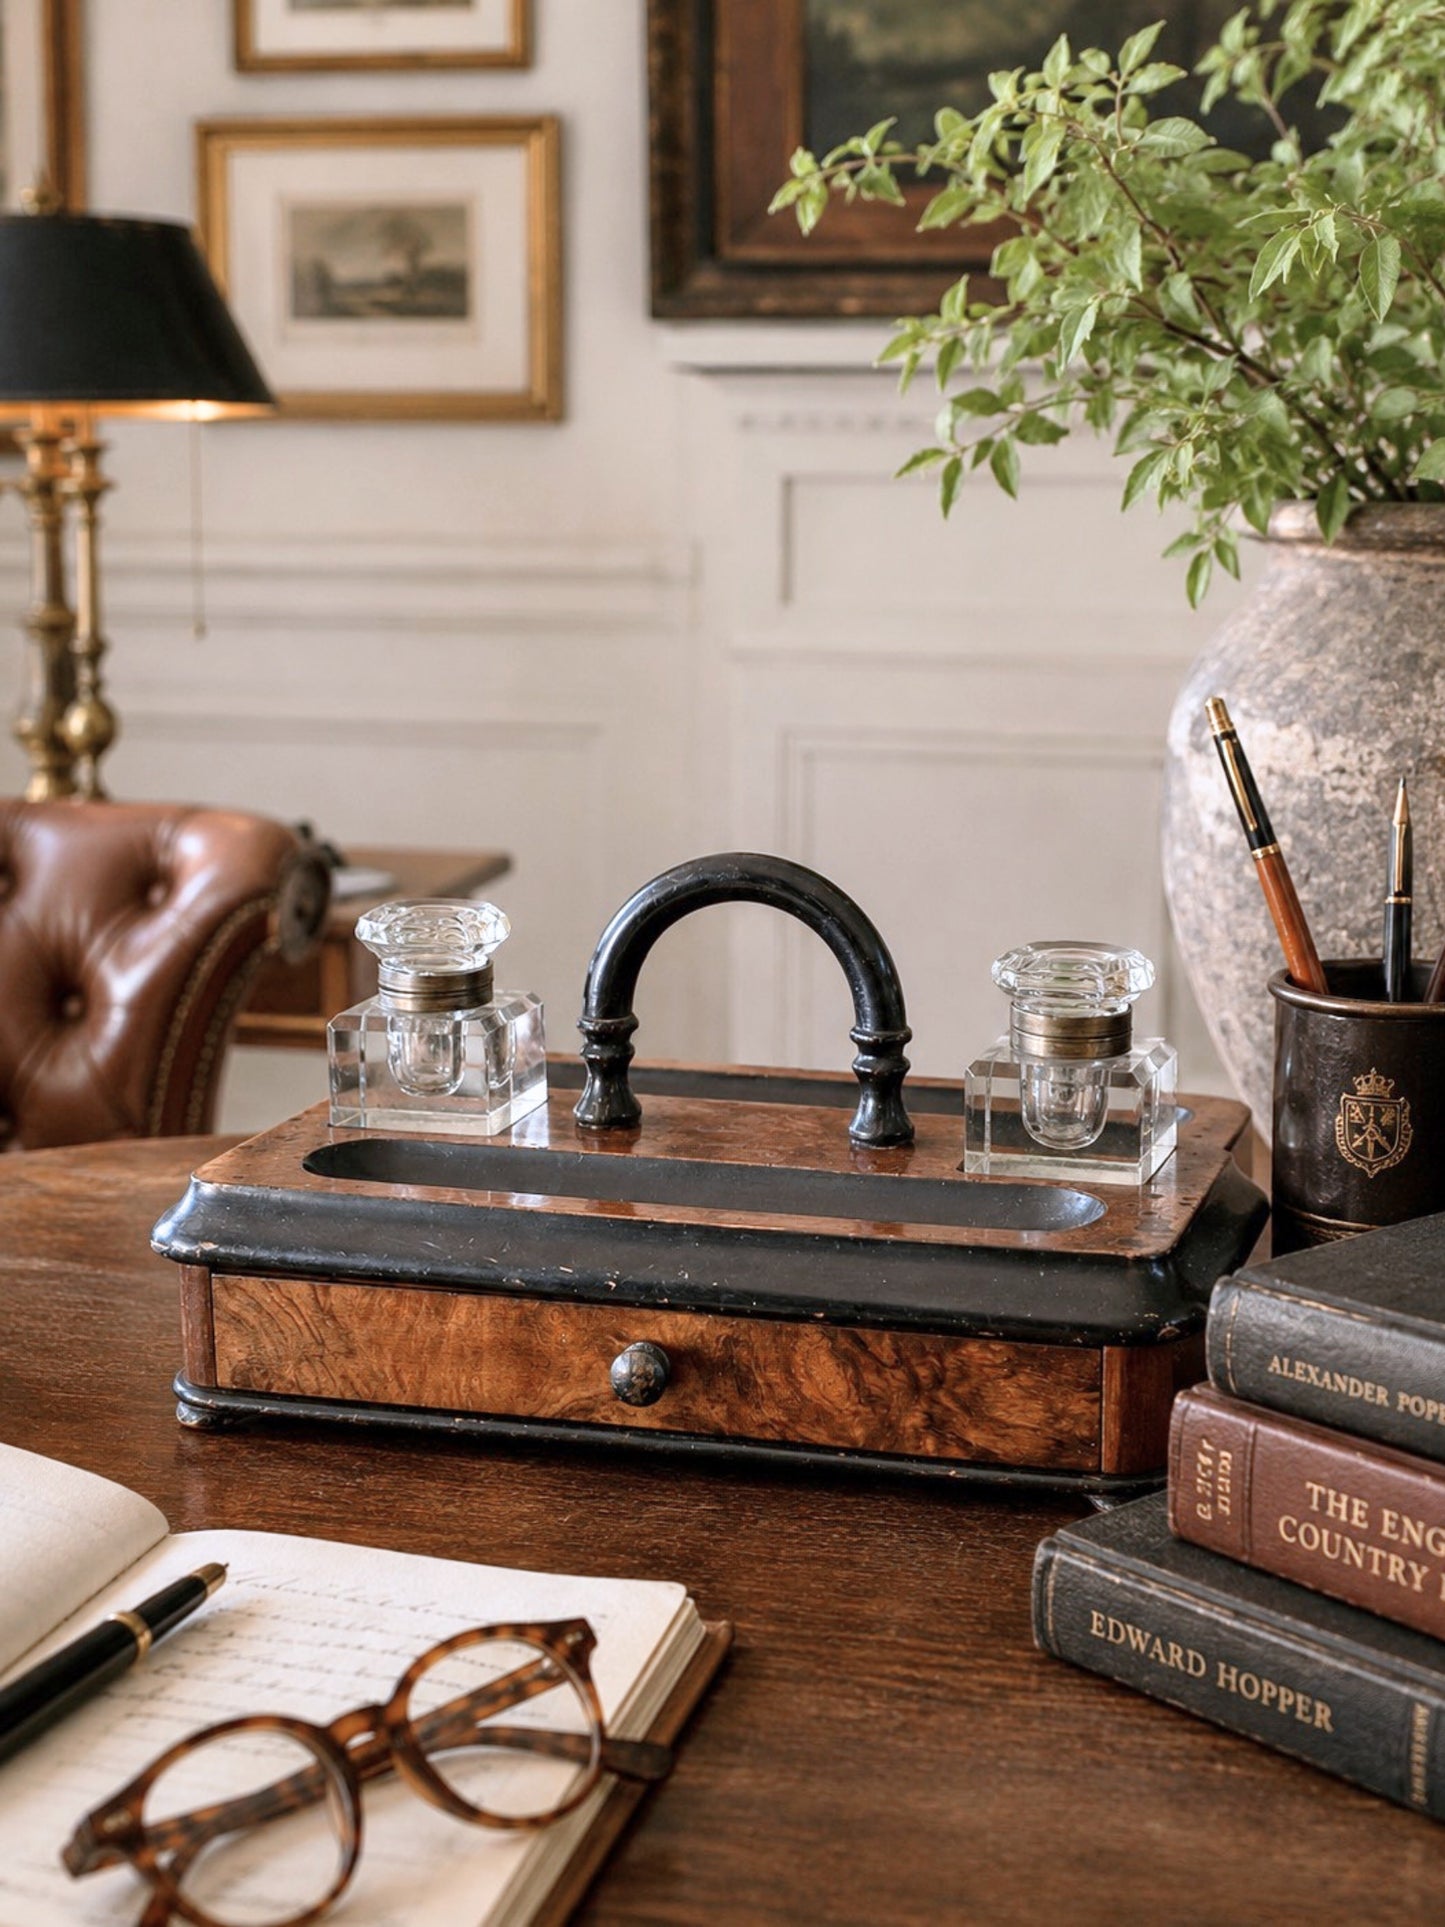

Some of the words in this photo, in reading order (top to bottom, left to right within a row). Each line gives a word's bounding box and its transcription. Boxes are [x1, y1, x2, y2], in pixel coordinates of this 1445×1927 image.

[1267, 1355, 1390, 1407] ALEXANDER
[1305, 1481, 1369, 1529] THE
[1278, 1515, 1430, 1593] COUNTRY
[1090, 1610, 1207, 1678] EDWARD
[1216, 1661, 1334, 1733] HOPPER
